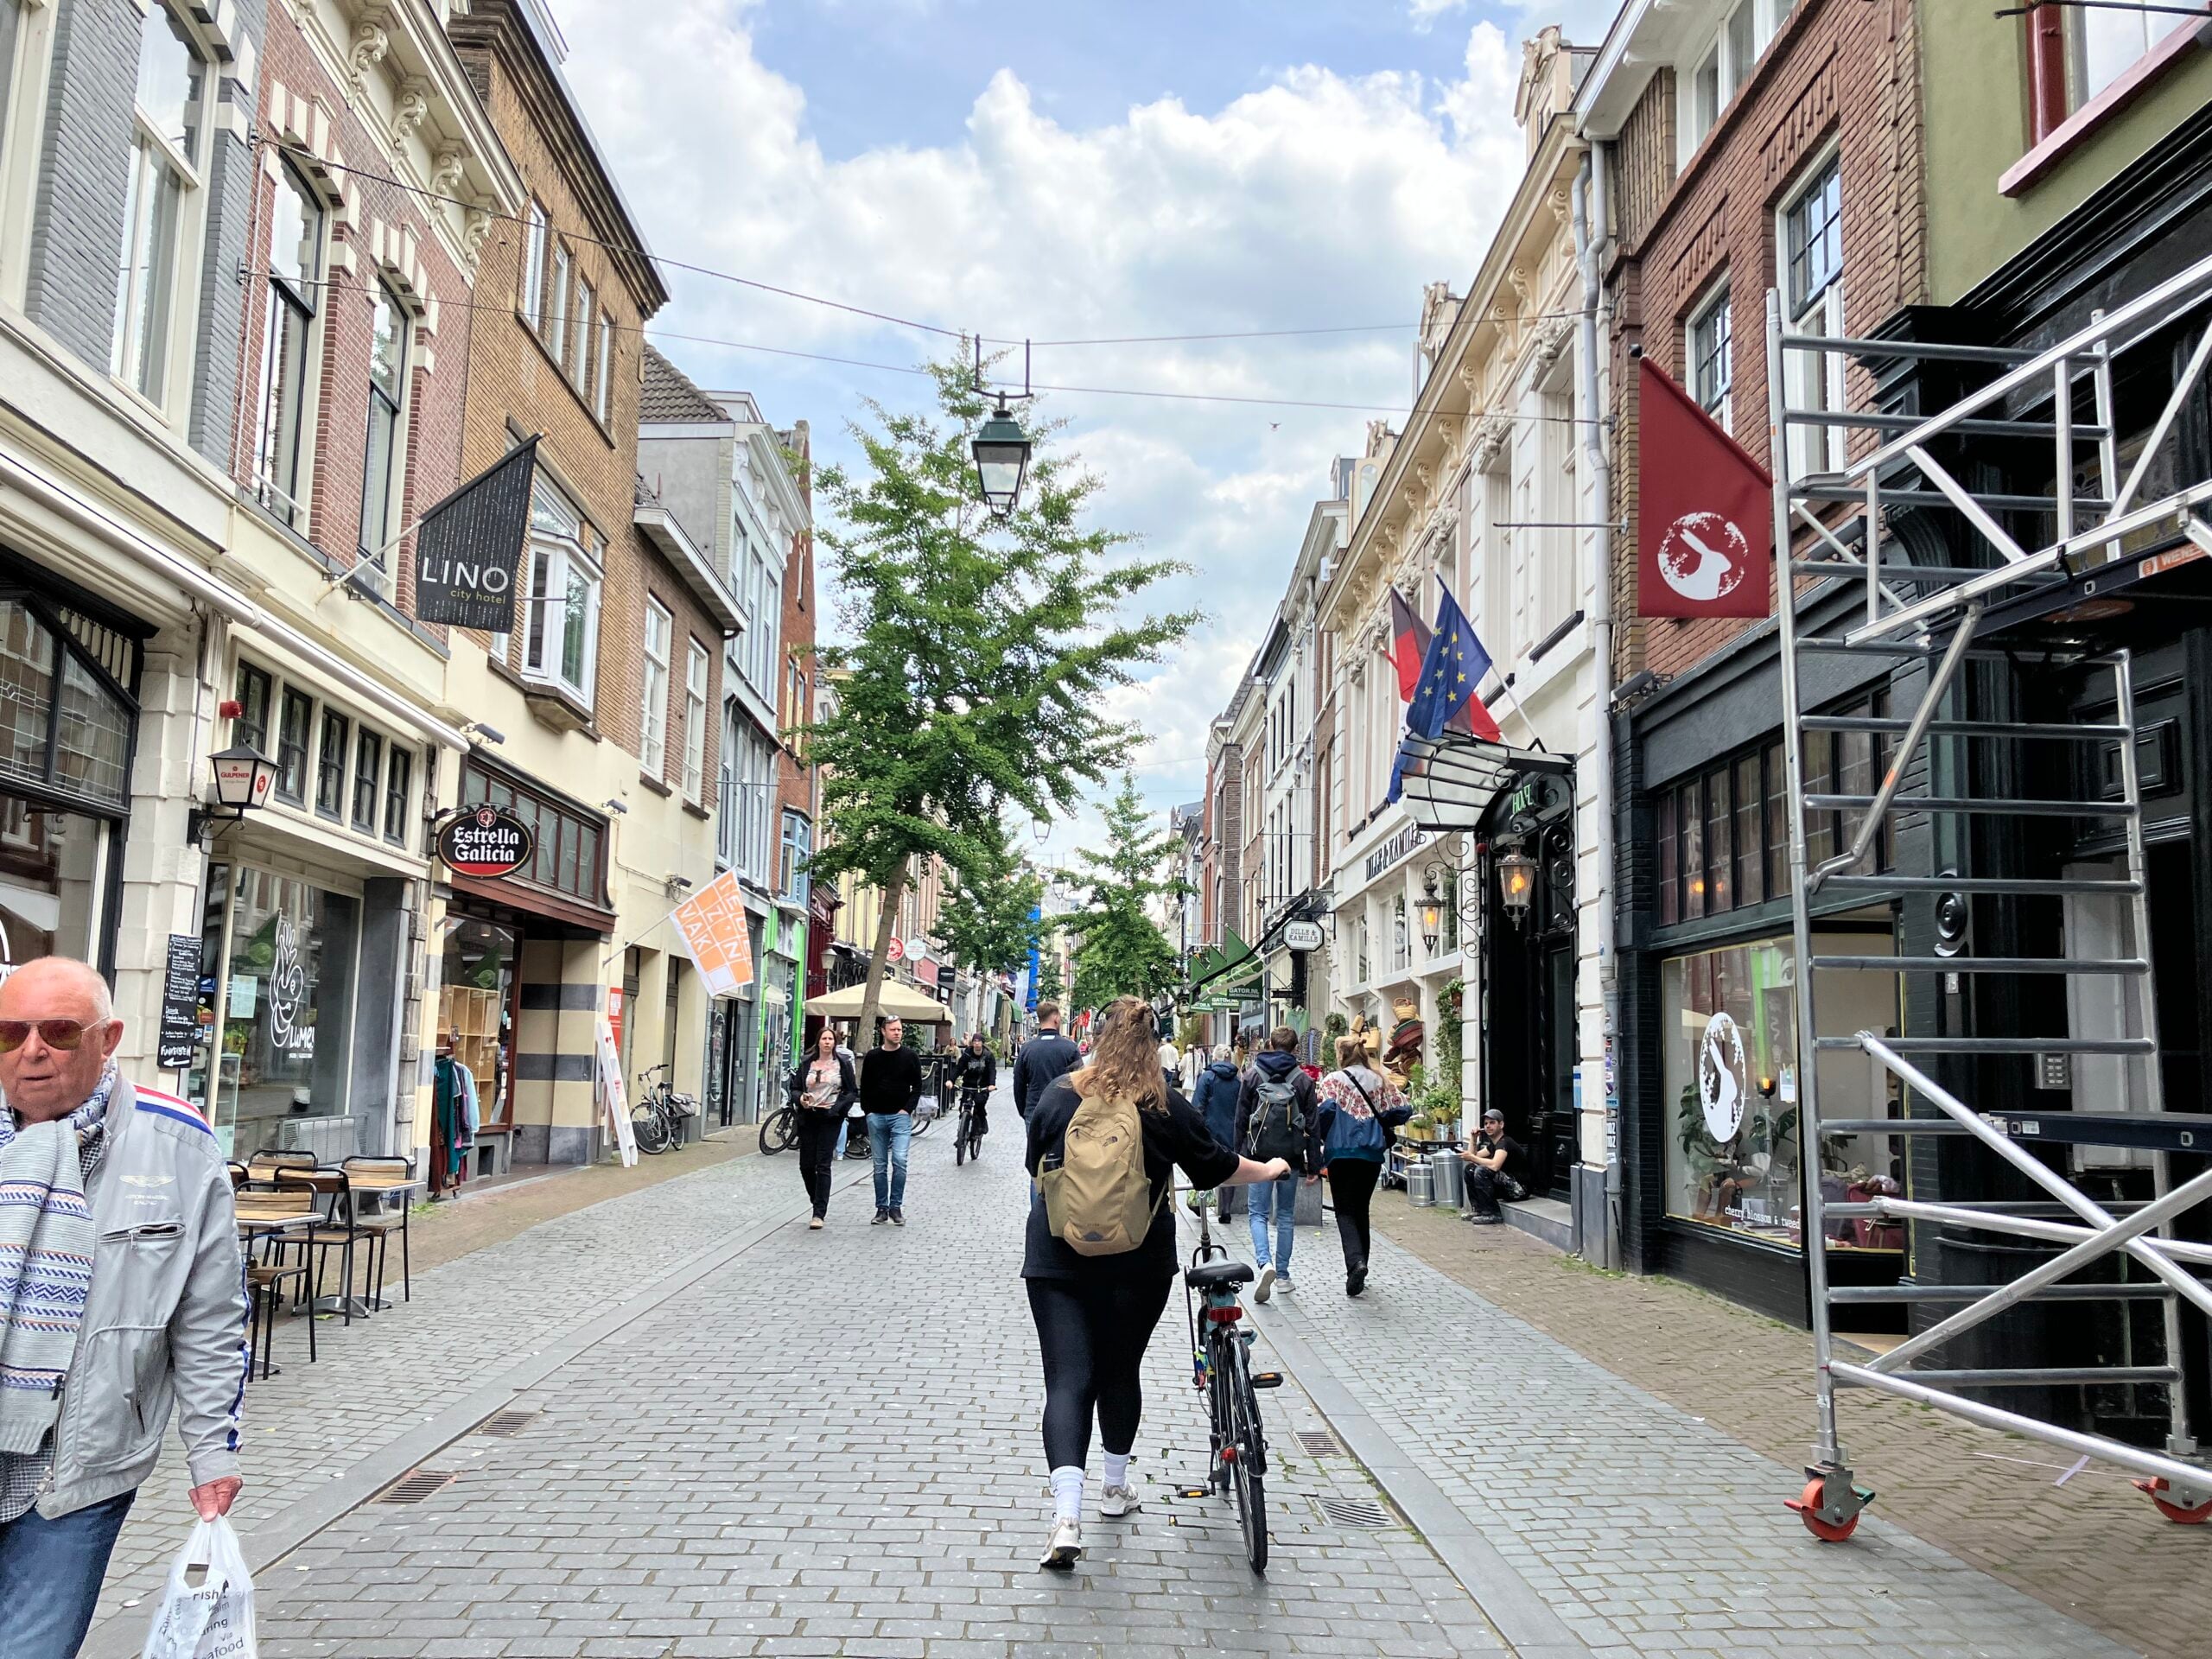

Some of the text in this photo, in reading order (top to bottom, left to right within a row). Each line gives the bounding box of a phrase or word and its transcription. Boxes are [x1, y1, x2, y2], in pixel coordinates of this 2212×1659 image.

[422, 556, 509, 593] LINO
[450, 588, 506, 604] city hotel
[452, 826, 519, 845] Estrella
[454, 843, 515, 862] Galicia
[681, 903, 713, 951] VAK
[1288, 934, 1319, 943] KAMILLE
[1725, 1205, 1745, 1220] cherry
[1747, 1210, 1771, 1224] blossom
[1781, 1217, 1801, 1229] tweed
